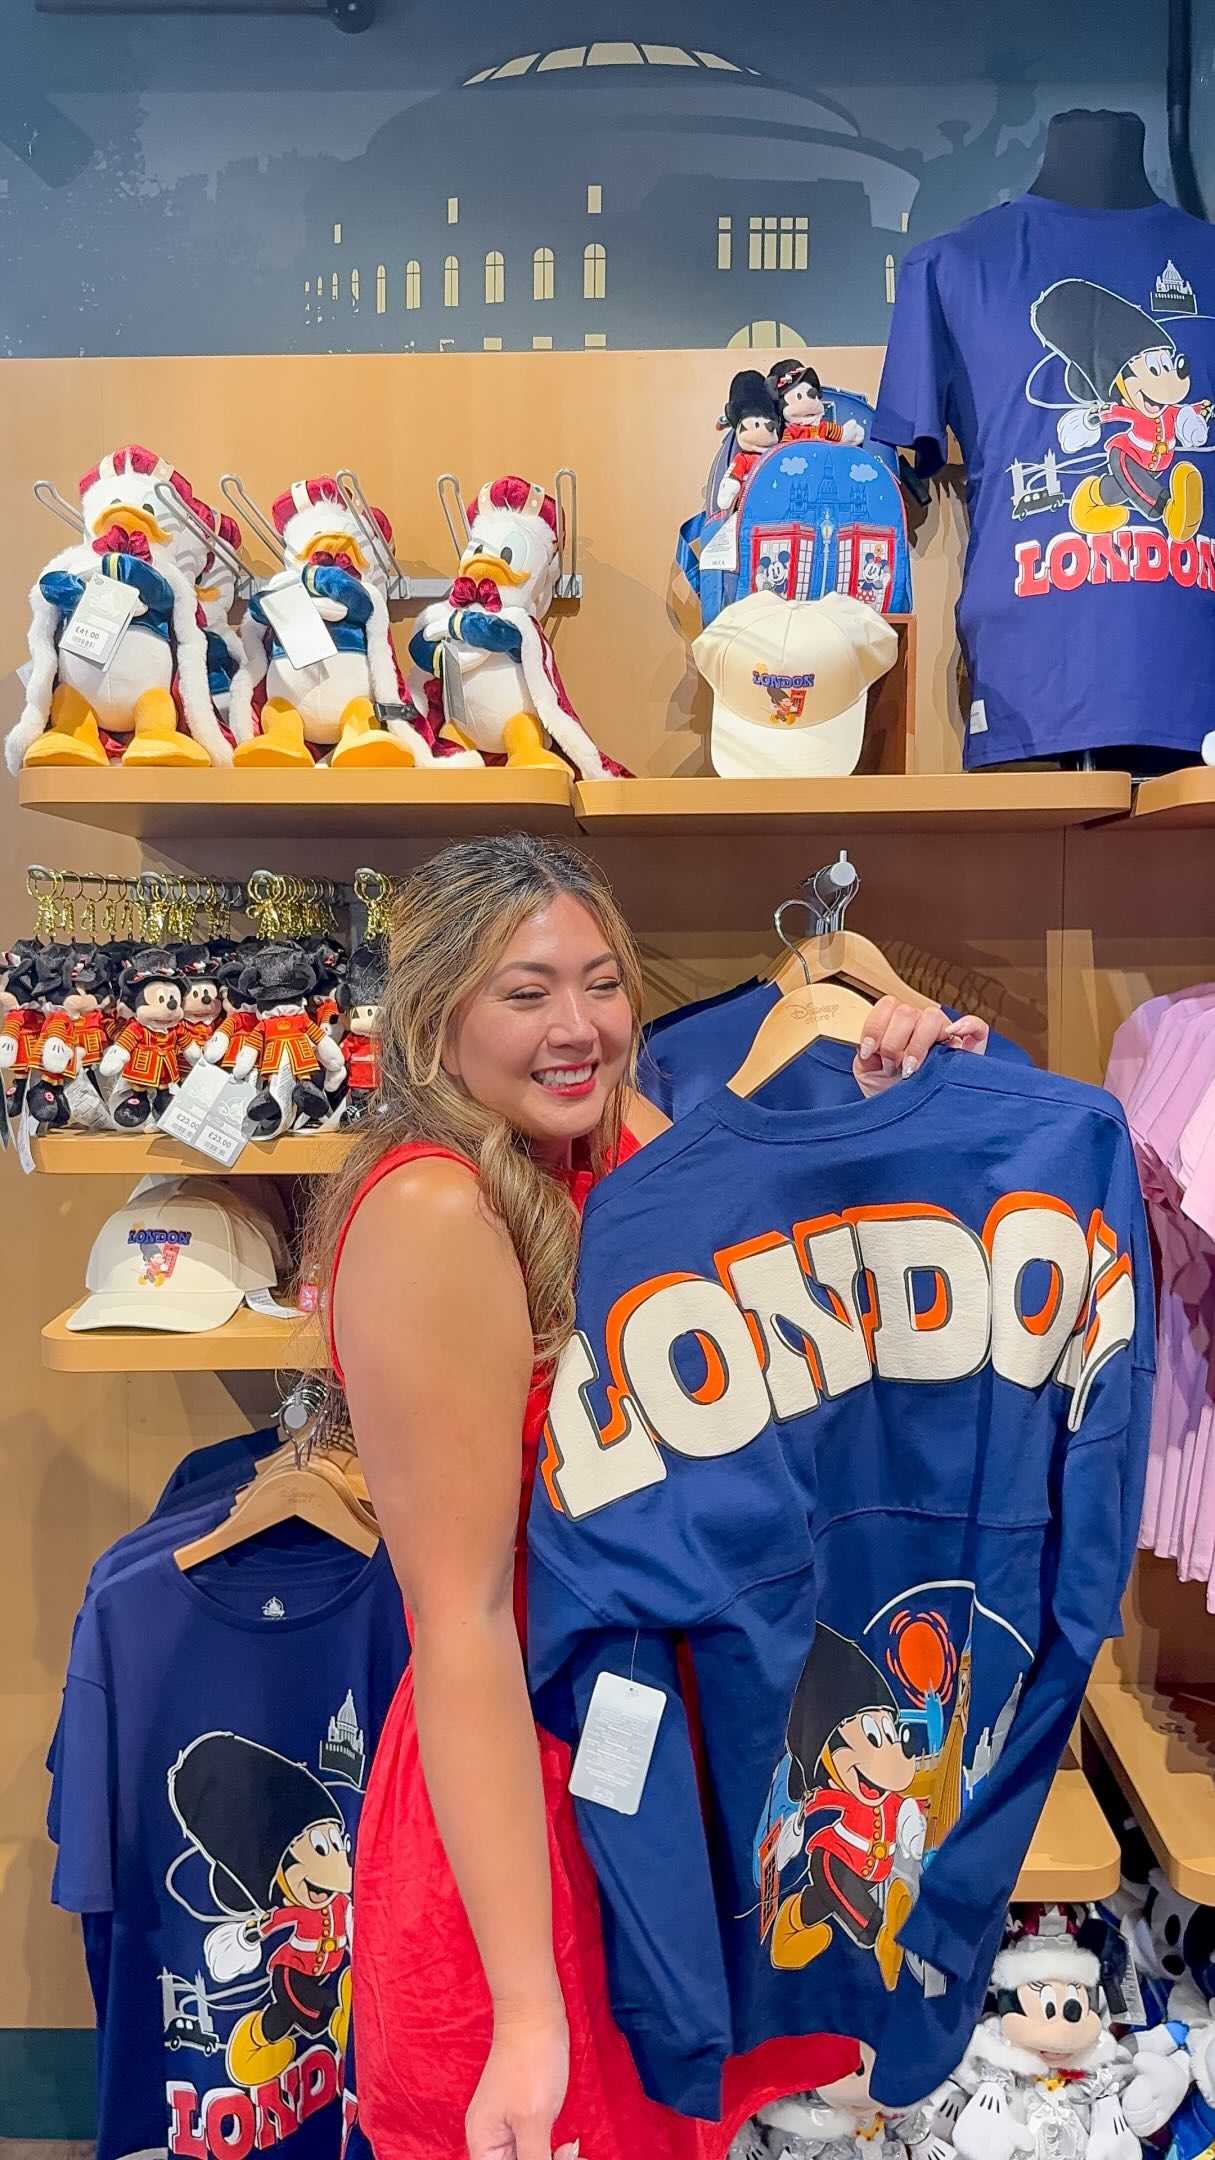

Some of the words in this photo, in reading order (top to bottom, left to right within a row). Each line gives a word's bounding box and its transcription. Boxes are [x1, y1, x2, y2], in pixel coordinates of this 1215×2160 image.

[75, 626, 100, 640] £41.00
[752, 670, 815, 689] LONDON
[207, 1131, 232, 1149] £23.00
[127, 1229, 192, 1245] LONDON
[166, 2044, 346, 2160] LOND
